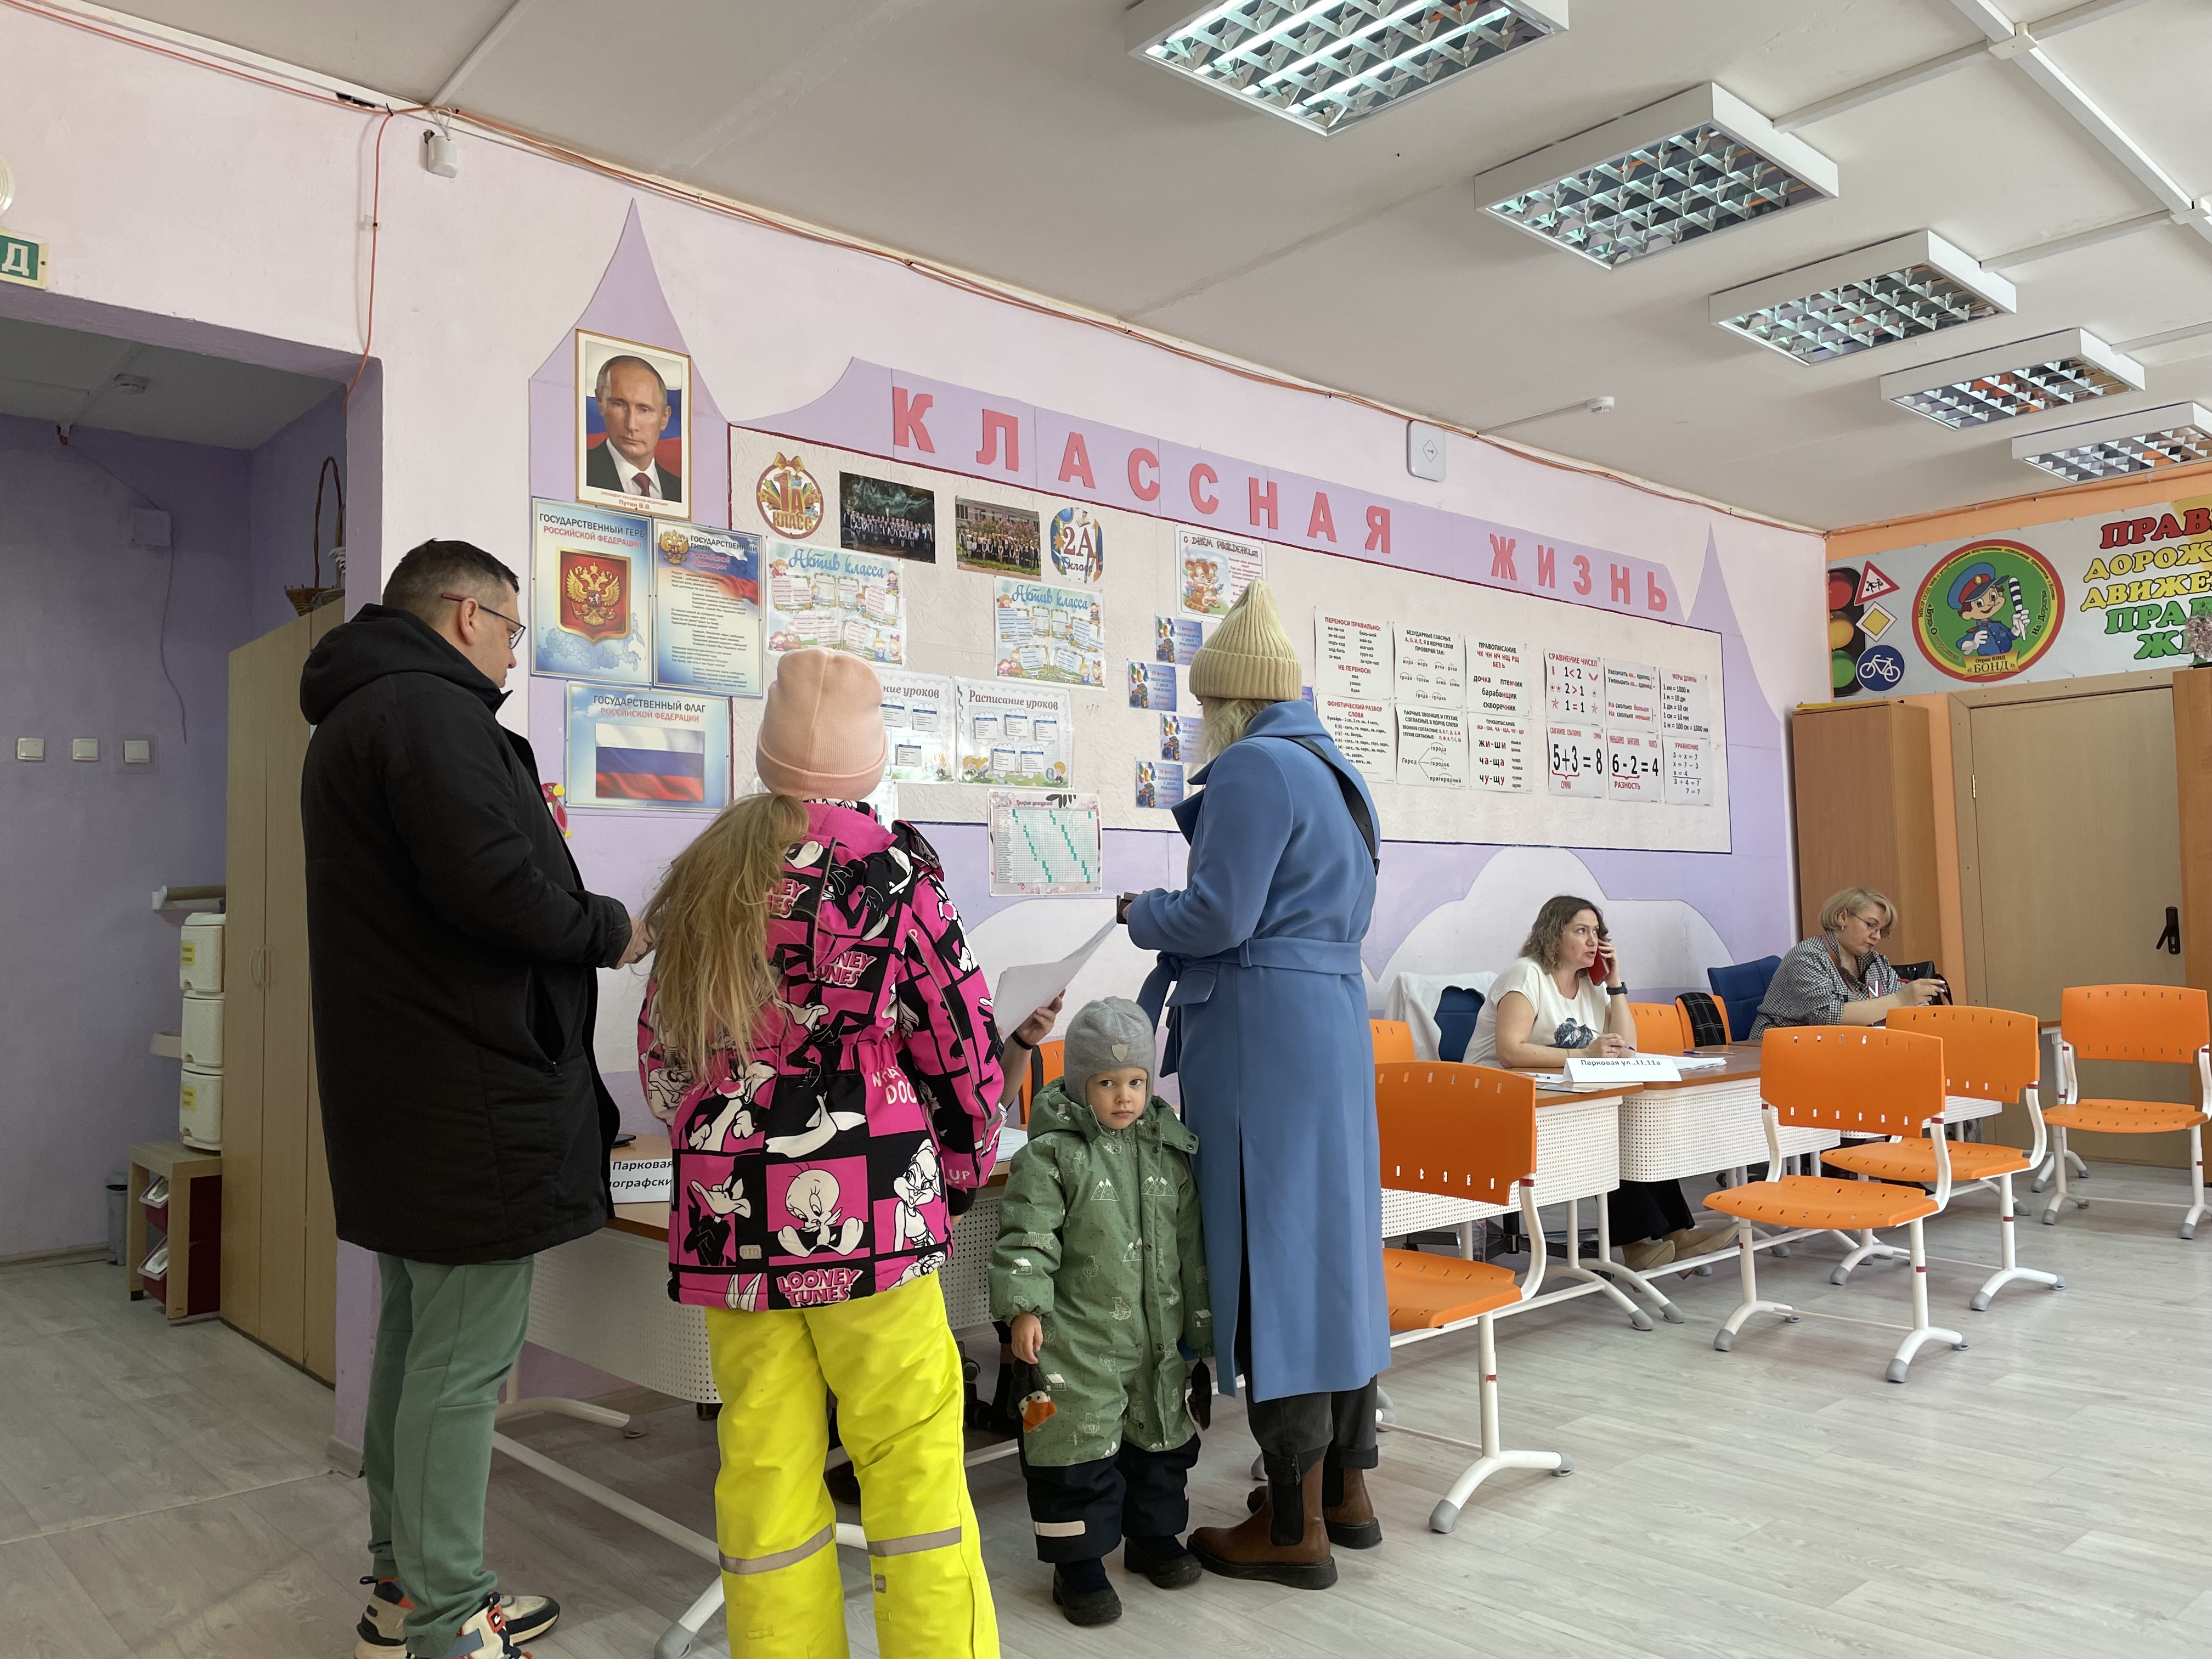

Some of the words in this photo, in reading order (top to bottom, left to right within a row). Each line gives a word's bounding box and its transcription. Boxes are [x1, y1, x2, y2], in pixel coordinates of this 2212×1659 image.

[893, 386, 1392, 554] КЛАССНАЯ
[1490, 533, 1668, 611] ЖИЗНЬ
[539, 513, 623, 534] ГОСУДАРСТВЕННЫЙ
[625, 528, 645, 538] ГЕРБ
[772, 510, 813, 532] КЛАСС
[2100, 507, 2212, 549] ПРАВ
[544, 526, 595, 540] РОССИЙСКОЙ
[597, 535, 641, 547] ФЕДЕРАЦИИ
[1063, 527, 1096, 558] 2А
[691, 535, 757, 552] ГОСУДАРСТВЕННЫЙ
[691, 543, 710, 552] ГИМН
[690, 552, 730, 563] РОССИЙСКОЙ
[788, 548, 840, 571] Актив
[845, 555, 885, 578] класса
[690, 560, 727, 570] ФЕДЕРАЦИИ
[1012, 584, 1053, 604] Актив
[1057, 589, 1088, 610] класса
[2080, 571, 2212, 612] ДВИЖЕ
[1325, 617, 1350, 626] ПЕРЕНОСИ
[1351, 621, 1381, 631] ПРАВИЛЬНО:
[1406, 630, 1432, 639] БЕЗУДАРНЫЕ
[1479, 642, 1516, 653] ПРАВОПИСАНИЕ
[1502, 654, 1510, 662] НЩ
[1548, 652, 1580, 664] СРАВНЕНИЕ
[1581, 658, 1598, 667] ЧИСЕЛ
[1346, 665, 1372, 674] ПЕРЕНОСИ:
[1500, 679, 1523, 687] птенчик
[903, 686, 939, 698] уроков
[1482, 687, 1517, 700] барабанщик
[594, 695, 681, 711] ГОСУДАРСТВЕННЫЙ
[684, 703, 706, 713] ФЛАГ
[969, 690, 1024, 706] Расписание
[1026, 697, 1058, 710] уроков
[1327, 701, 1364, 709] ФОНЕТИЧЕСКИЙ
[1483, 702, 1516, 711] скворечник
[601, 708, 653, 719] РОССИЙСКОЙ
[654, 713, 699, 723] ФЕДЕРАЦИИ
[1479, 740, 1506, 749] жи-ши
[1674, 742, 1699, 751] УРАВНЕНИЕ
[1479, 757, 1504, 768] ча-ща
[1479, 775, 1505, 786] чу-щу
[1614, 781, 1641, 790] РАЗНОСТЬ
[885, 1080, 917, 1104] DOC
[612, 1161, 673, 1171] Парковая
[776, 1268, 864, 1294] LOONEY
[785, 1286, 851, 1307] TUNES
